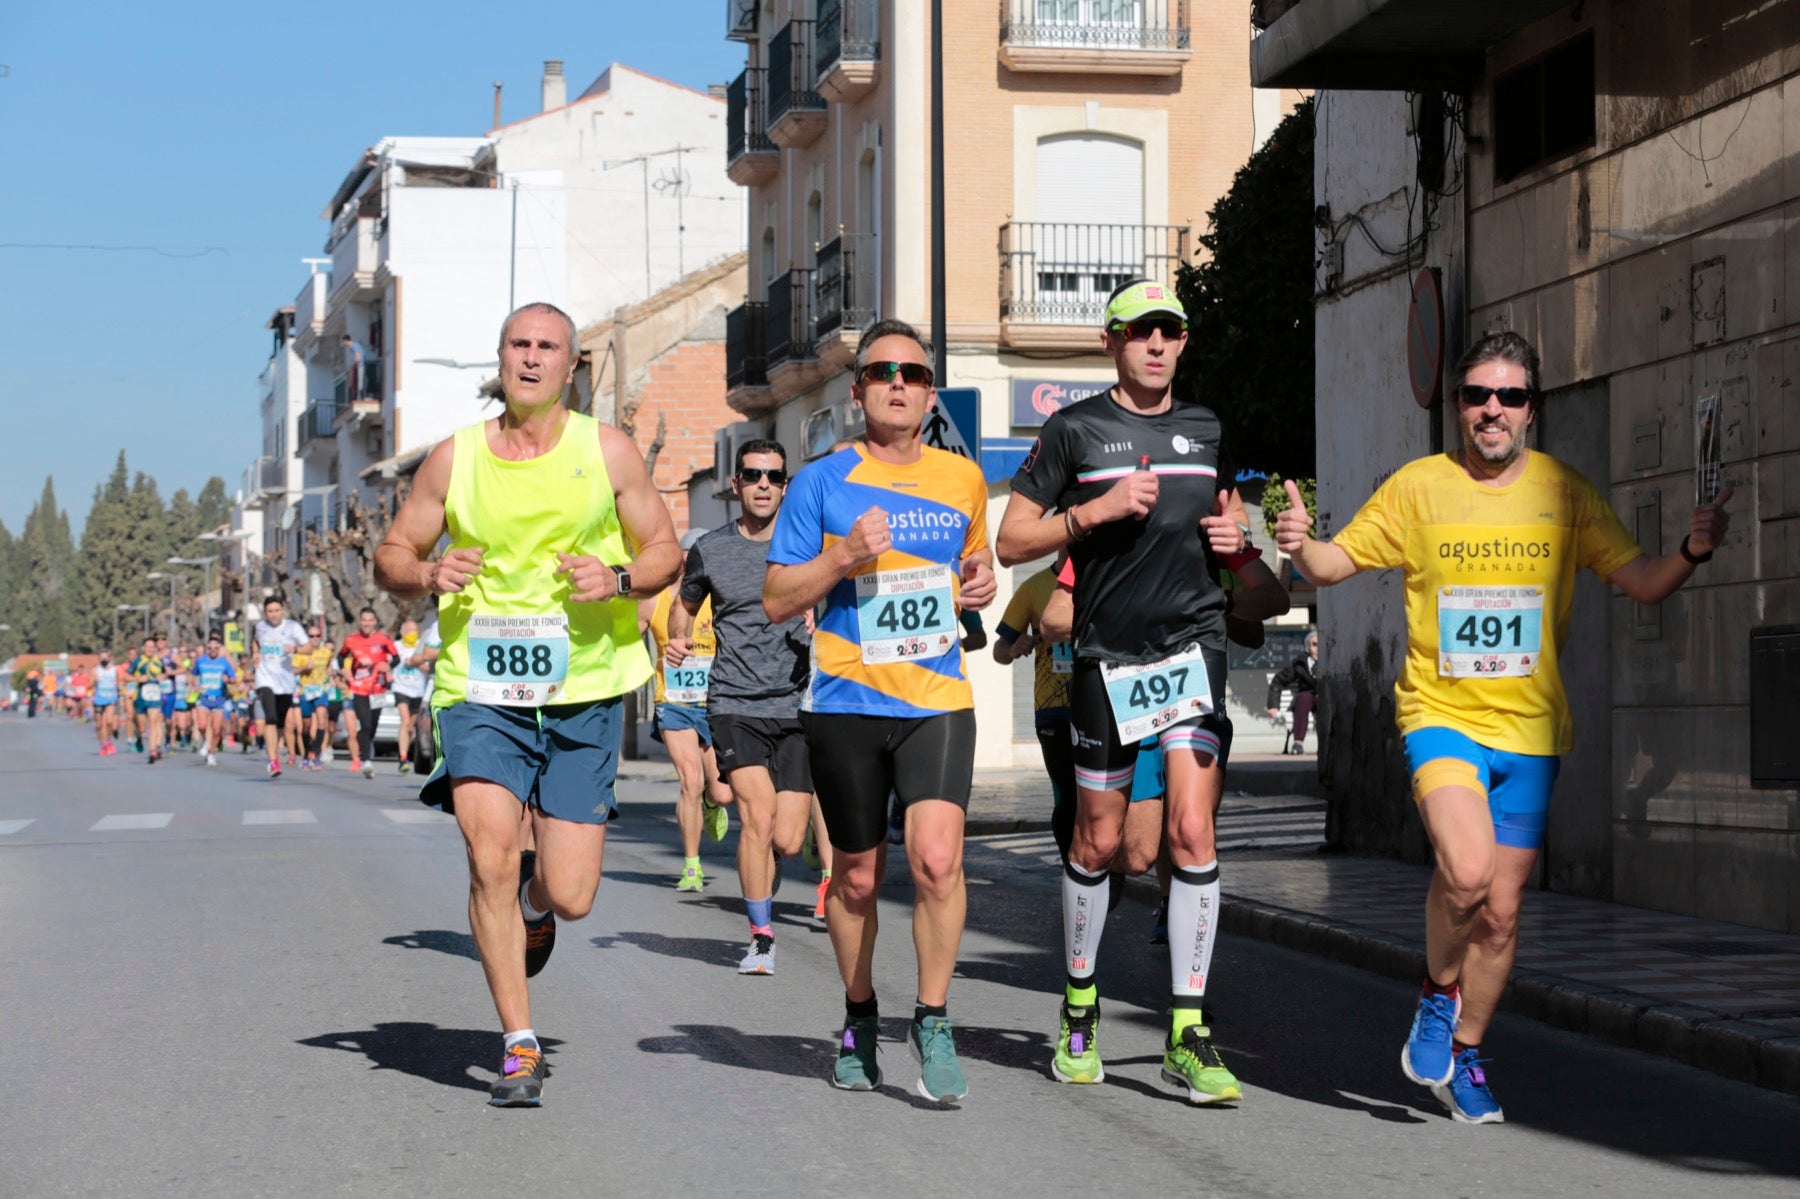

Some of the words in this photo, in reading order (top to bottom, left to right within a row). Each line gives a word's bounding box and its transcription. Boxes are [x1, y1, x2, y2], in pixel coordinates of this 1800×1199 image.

[1439, 537, 1550, 563] agustinos
[881, 573, 898, 584] GRAN
[900, 571, 919, 581] PREMIO
[920, 570, 928, 579] DE
[928, 568, 945, 577] FONDO
[1456, 563, 1536, 572] GRANADA
[1465, 589, 1483, 597] GRAN
[1484, 589, 1508, 598] PREMIO
[1509, 589, 1517, 597] DE
[490, 618, 506, 627] GRAN
[507, 618, 531, 627] PREMIO
[531, 617, 540, 626] DE
[541, 617, 562, 626] FONDO
[876, 596, 940, 632] 482
[1456, 615, 1522, 648] 491
[486, 644, 552, 676] 888
[674, 670, 706, 687] 123
[1129, 666, 1189, 709] 497
